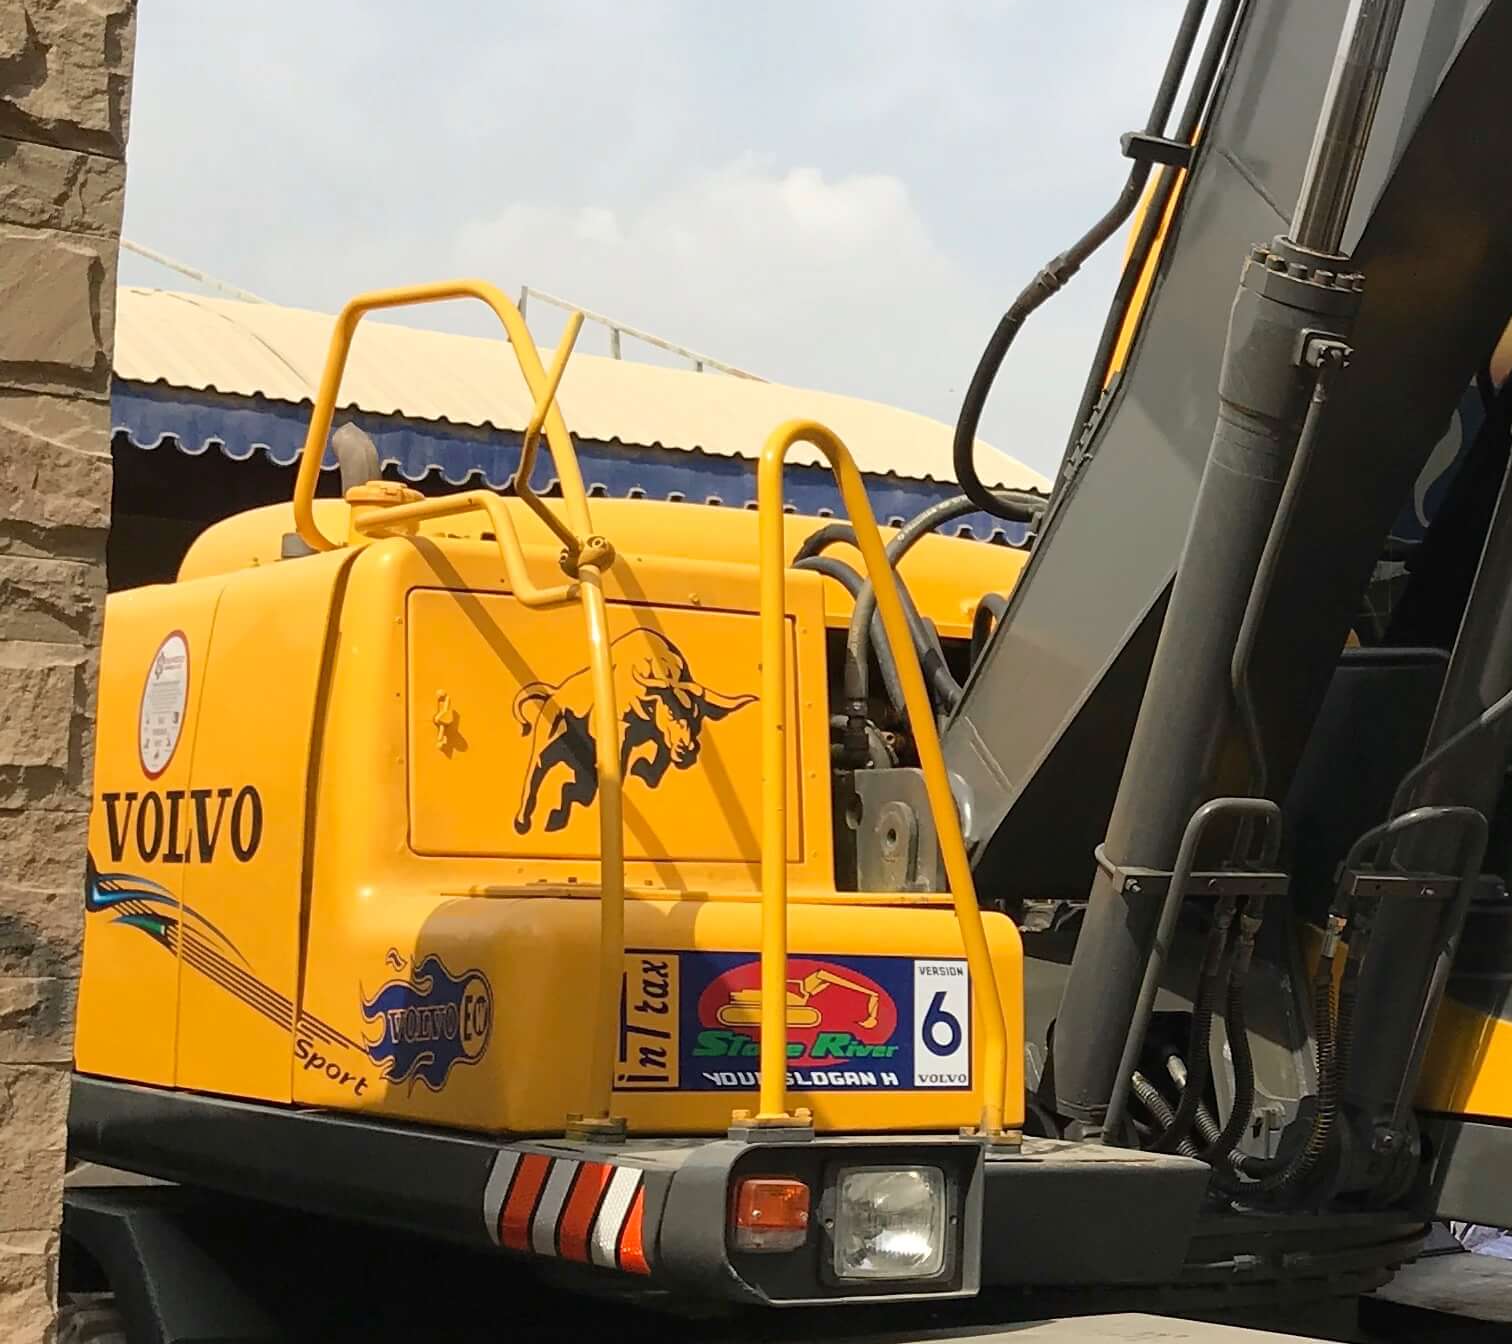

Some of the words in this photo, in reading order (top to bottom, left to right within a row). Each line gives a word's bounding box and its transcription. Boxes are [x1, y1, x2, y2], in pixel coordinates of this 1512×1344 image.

[102, 785, 263, 864] VOLVO
[919, 966, 964, 977] VERSION
[387, 1003, 459, 1044] VOLVO
[922, 991, 962, 1057] 6
[811, 1032, 899, 1058] River
[294, 1037, 368, 1096] Sport
[703, 1072, 763, 1086] YOU
[785, 1071, 877, 1086] SLOGAN
[919, 1074, 967, 1084] VOLVO
